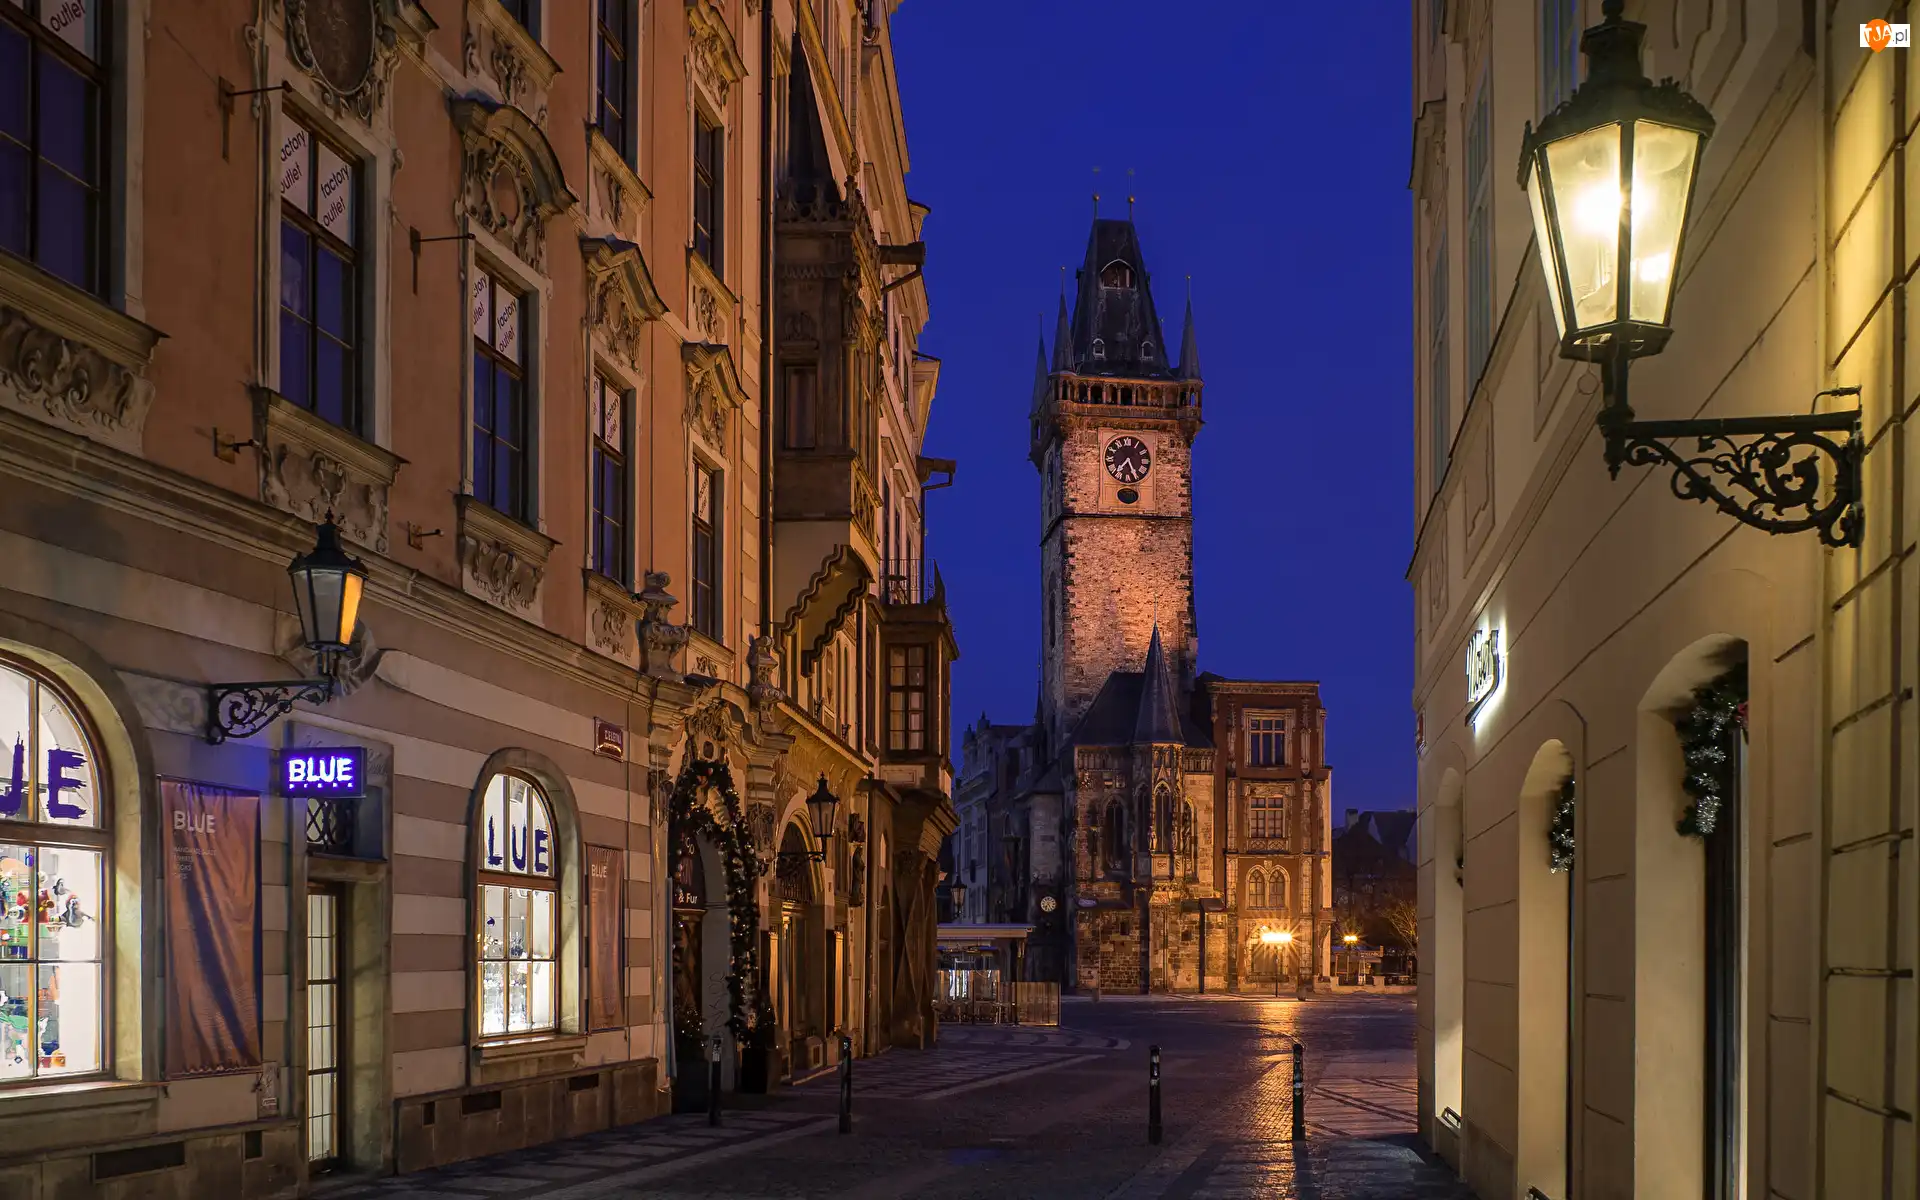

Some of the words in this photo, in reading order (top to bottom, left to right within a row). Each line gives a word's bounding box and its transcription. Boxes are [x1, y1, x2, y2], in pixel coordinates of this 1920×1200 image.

[281, 130, 307, 162] actory
[320, 165, 350, 199] factory
[322, 196, 346, 228] outlet
[288, 756, 354, 782] BLUE
[173, 810, 217, 834] BLUE
[591, 864, 608, 878] BLUE
[686, 893, 698, 904] Fur
